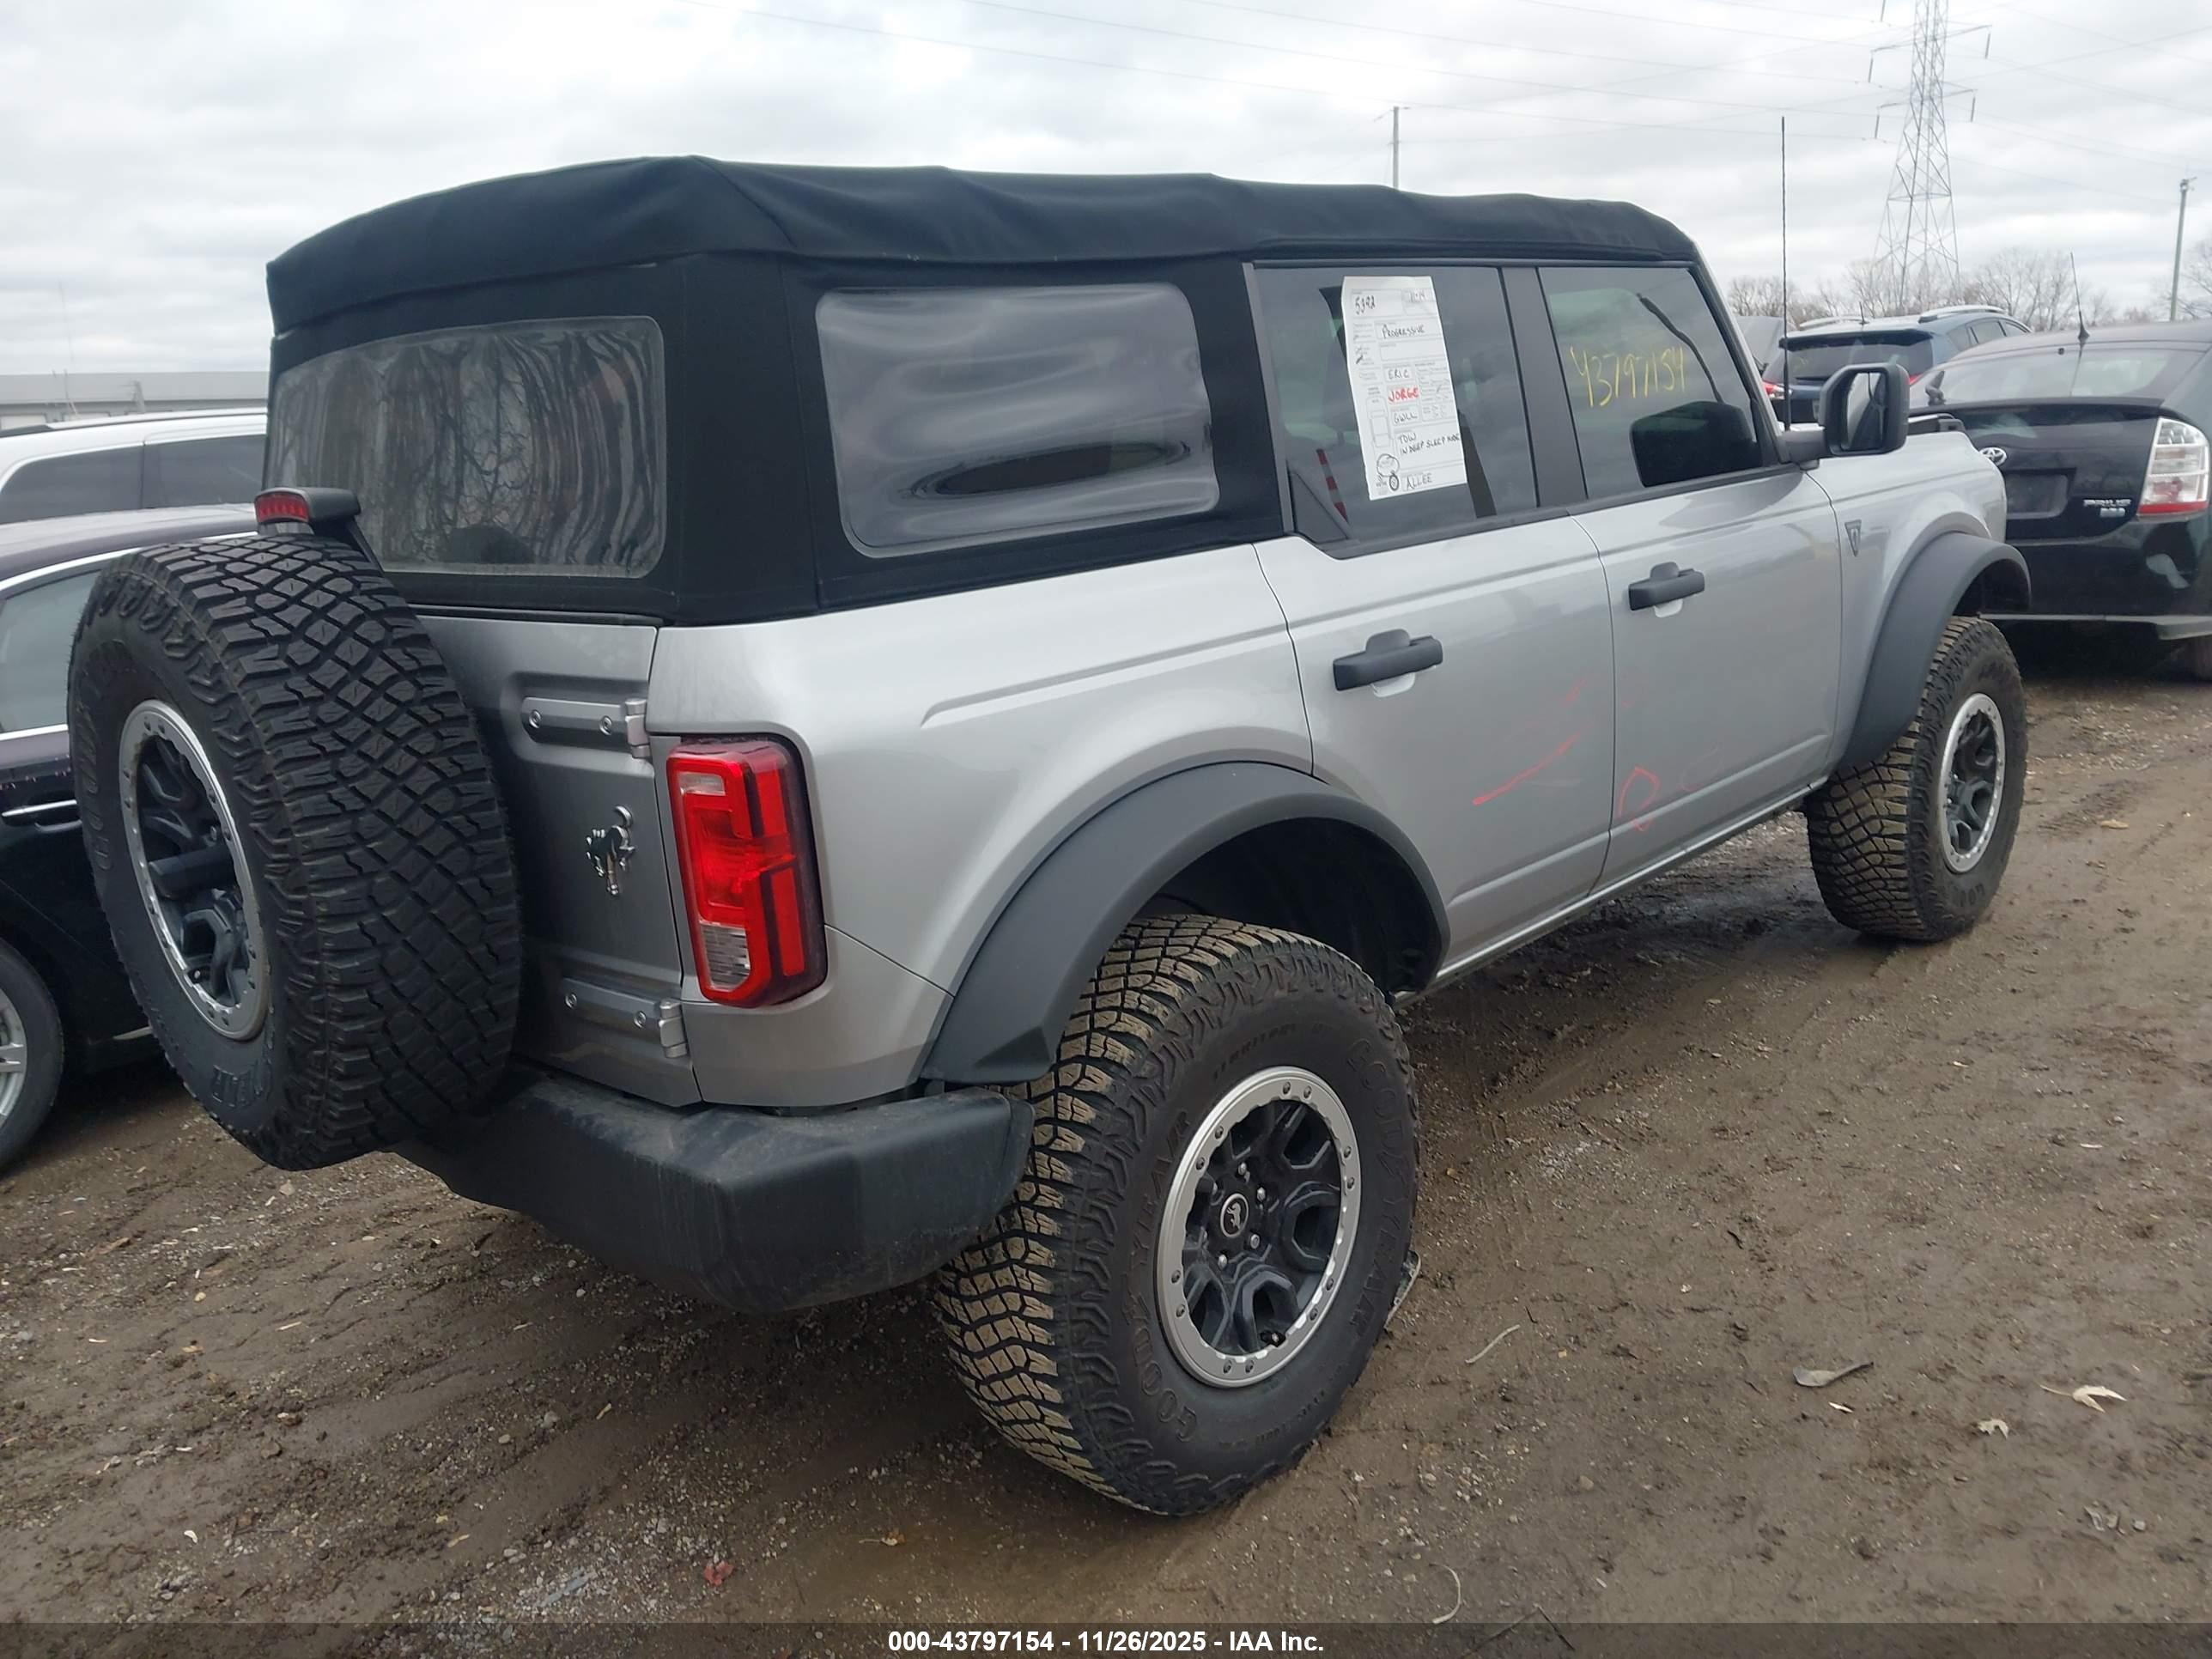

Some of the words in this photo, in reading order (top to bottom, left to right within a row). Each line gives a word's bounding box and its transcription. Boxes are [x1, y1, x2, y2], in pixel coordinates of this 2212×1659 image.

[1388, 368, 1410, 380] ERIC
[1570, 346, 1686, 408] 43797154
[1388, 386, 1420, 402] JORGE
[1398, 432, 1417, 444] TOW
